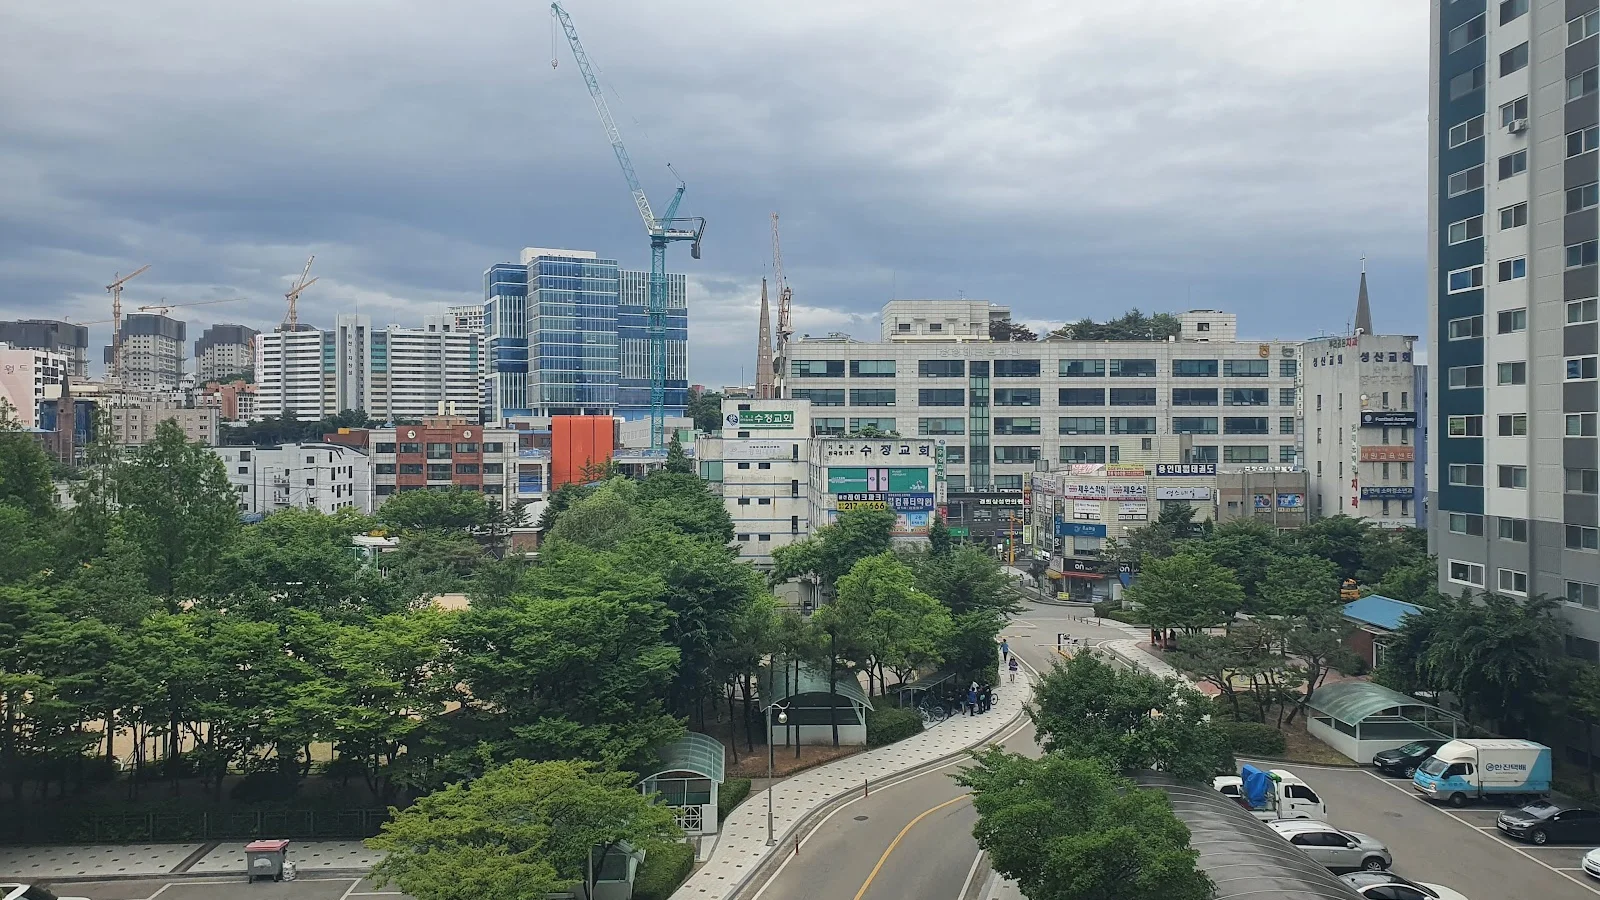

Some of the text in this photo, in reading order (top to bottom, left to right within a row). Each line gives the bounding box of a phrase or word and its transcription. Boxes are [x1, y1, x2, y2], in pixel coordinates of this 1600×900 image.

[1312, 354, 1343, 368] 성산교회
[1360, 351, 1411, 363] 성산교회
[754, 413, 792, 424] 수정교회
[860, 444, 930, 457] 수정교회
[1495, 763, 1527, 771] 한진택배
